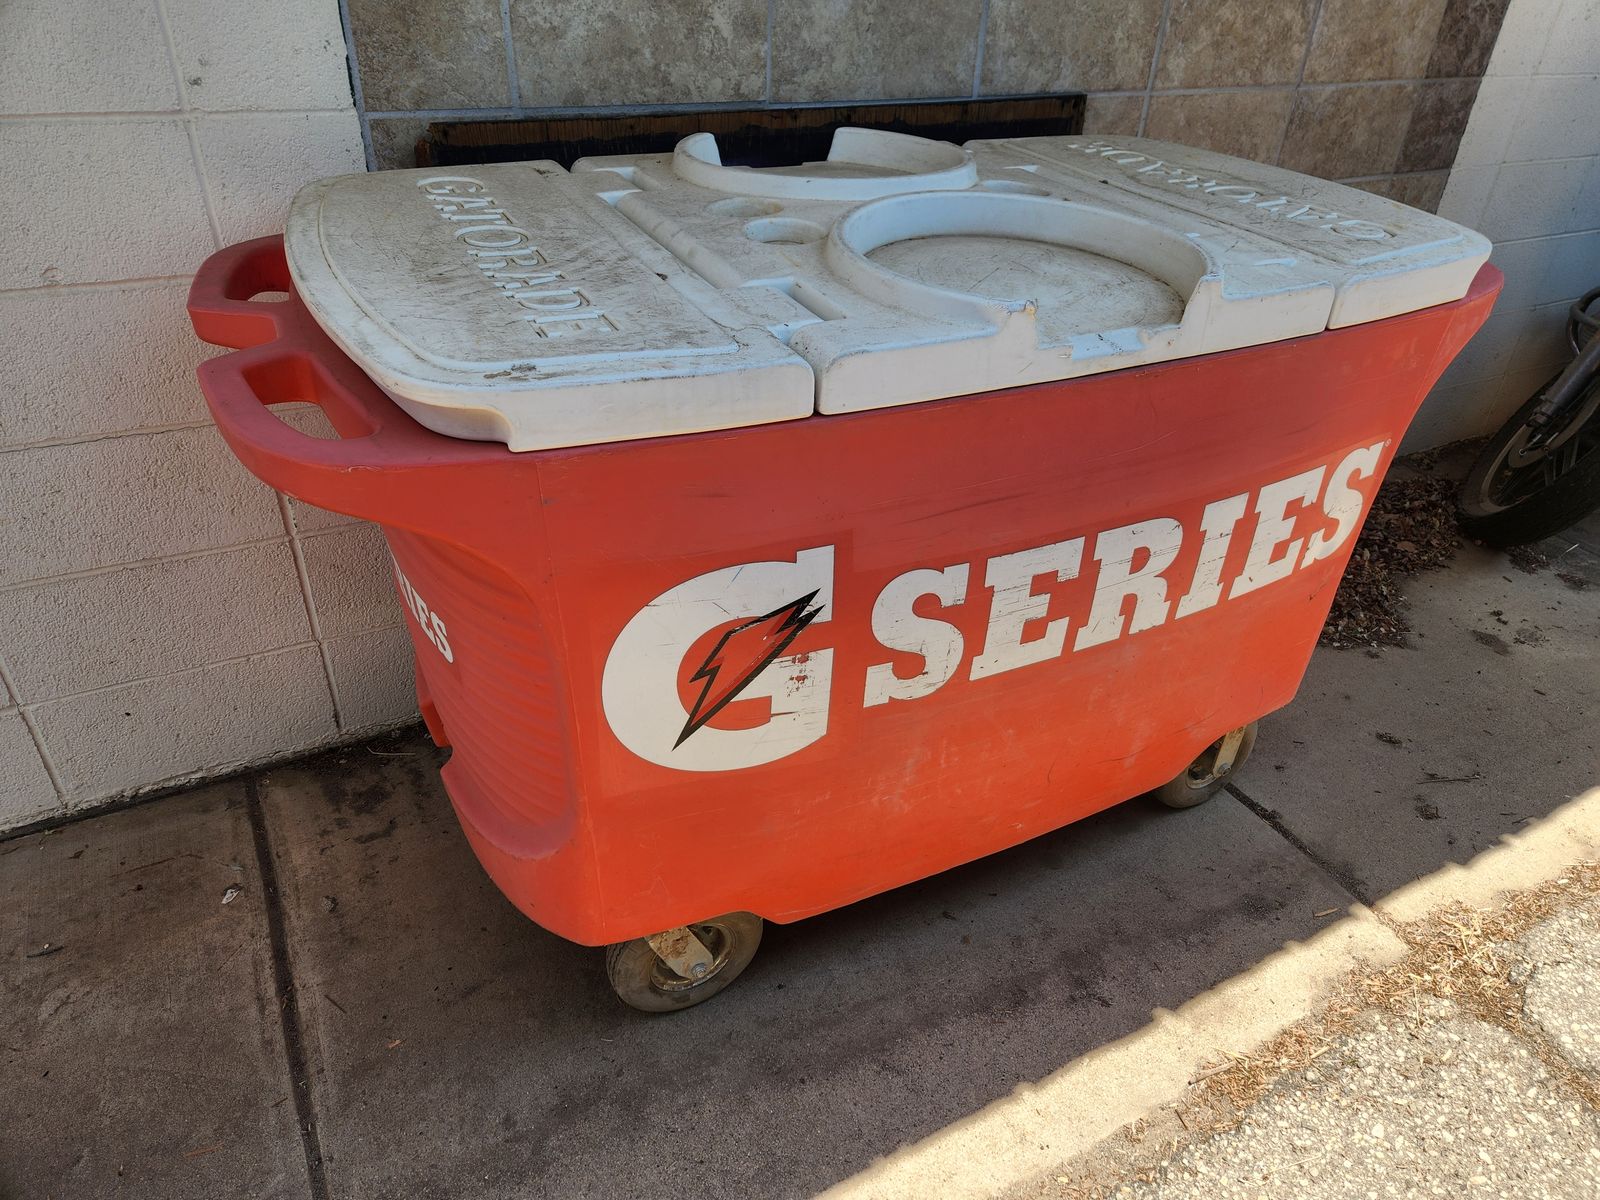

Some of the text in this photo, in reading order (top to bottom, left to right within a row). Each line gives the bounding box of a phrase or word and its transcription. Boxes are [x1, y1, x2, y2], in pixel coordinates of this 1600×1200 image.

[416, 176, 620, 339] GATORADE
[388, 546, 454, 664] RIES
[601, 441, 1385, 772] G SERIES
